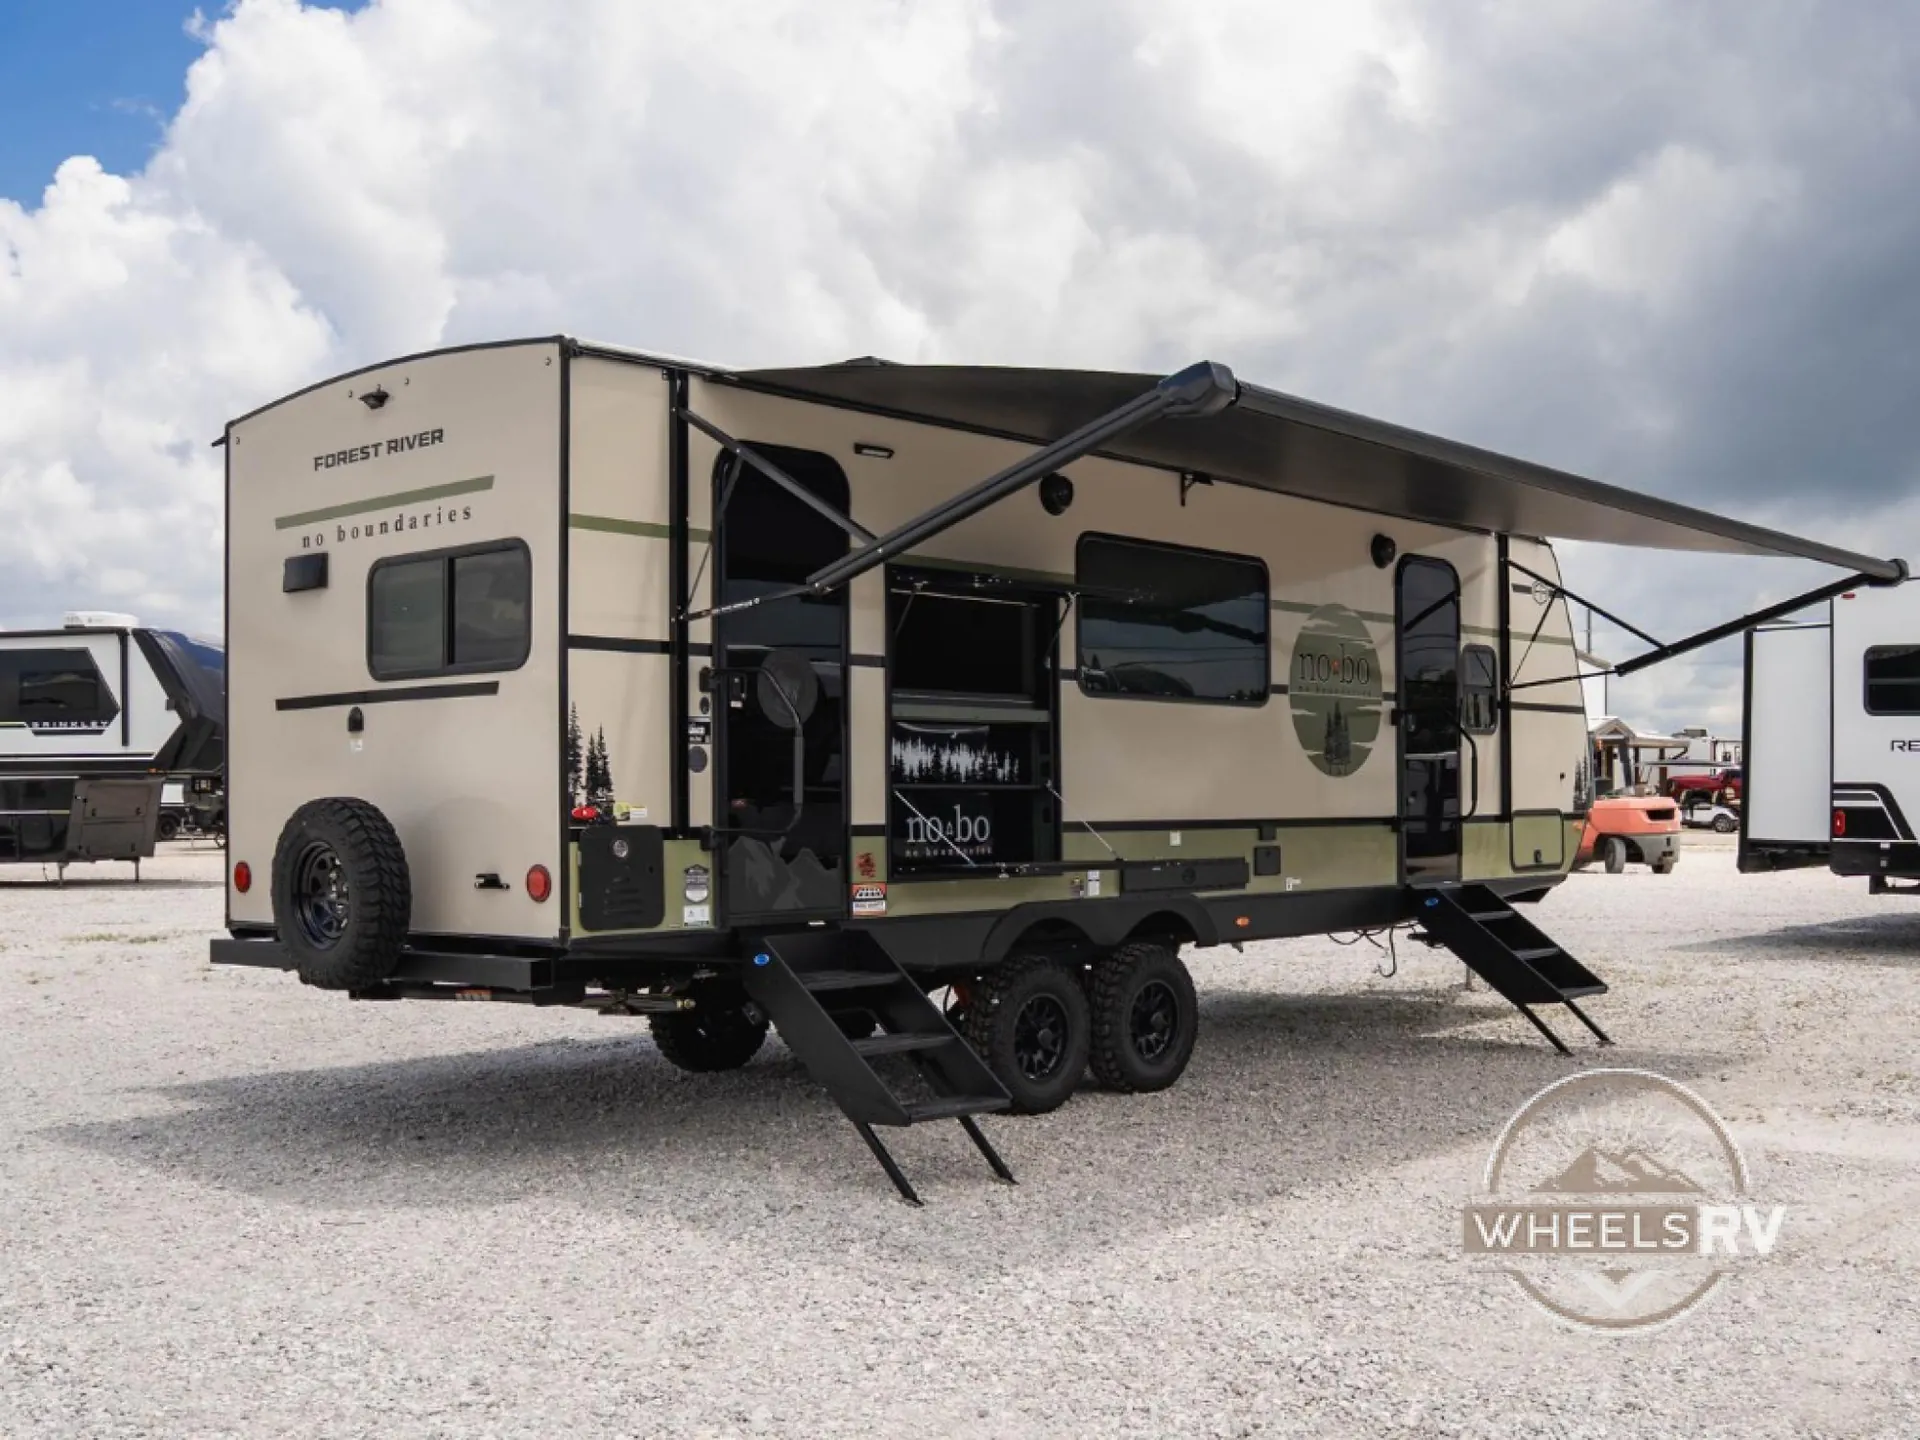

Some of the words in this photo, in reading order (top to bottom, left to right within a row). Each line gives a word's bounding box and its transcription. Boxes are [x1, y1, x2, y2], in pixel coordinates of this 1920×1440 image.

[313, 442, 383, 471] FOREST
[386, 428, 444, 455] RIVER
[302, 533, 324, 549] no
[337, 505, 472, 543] boundaries
